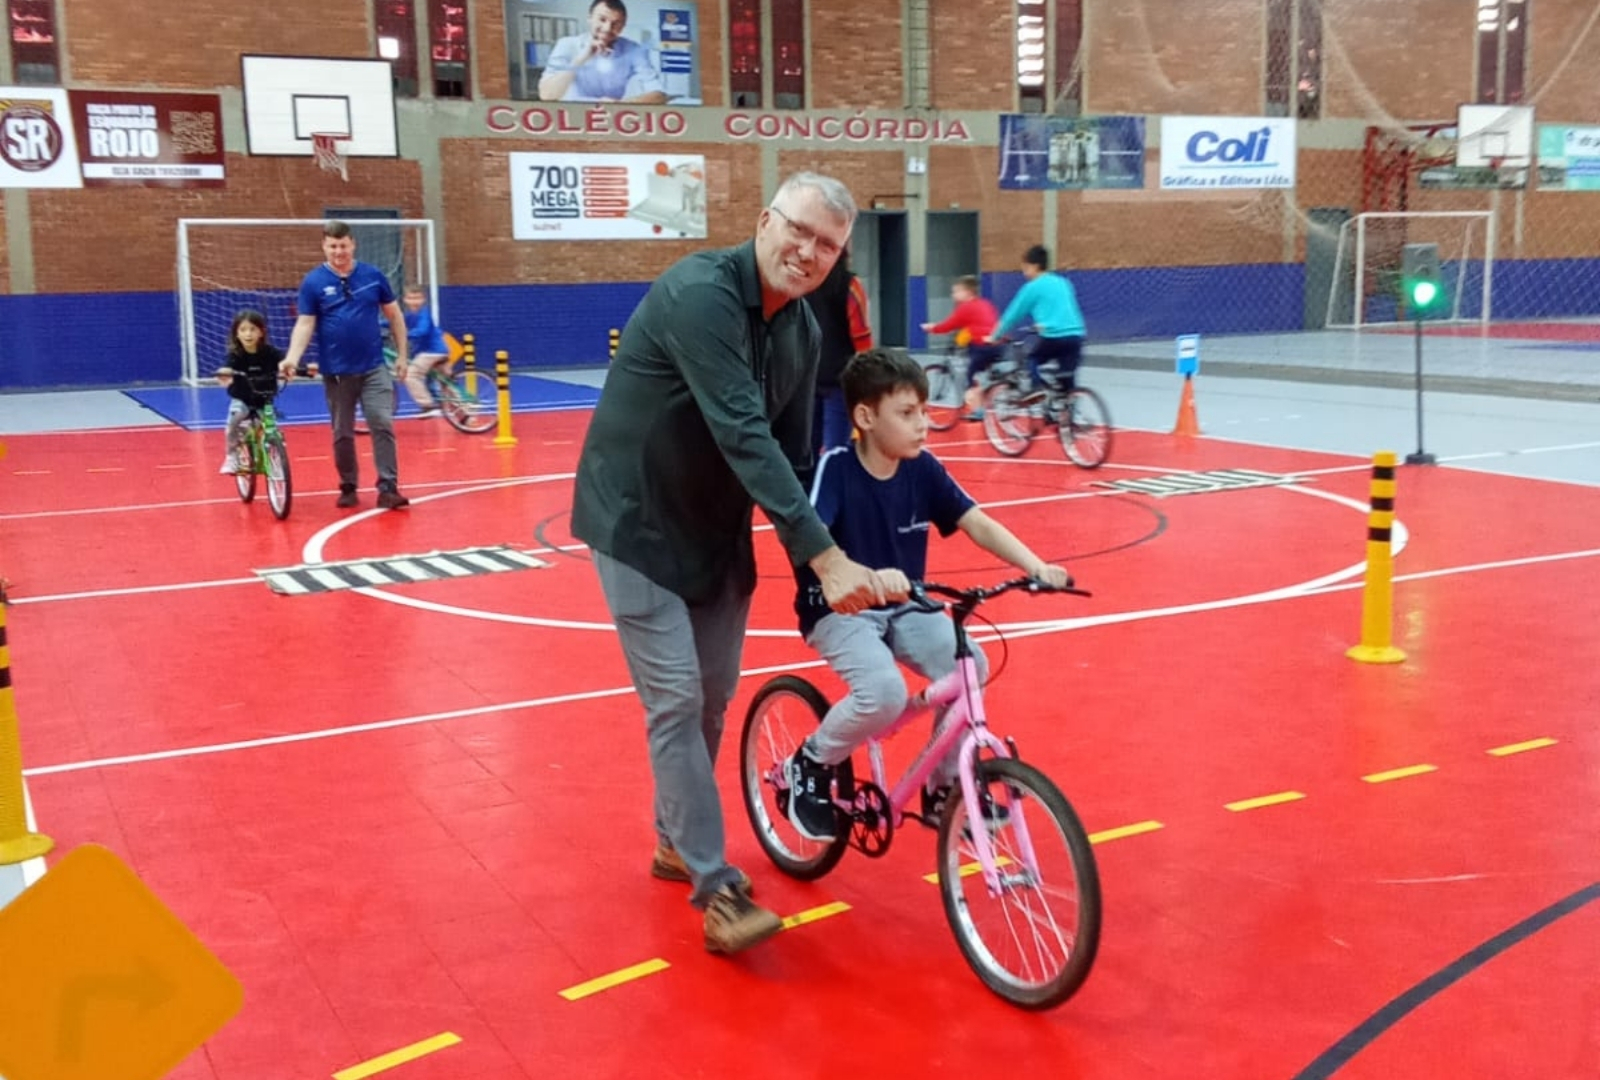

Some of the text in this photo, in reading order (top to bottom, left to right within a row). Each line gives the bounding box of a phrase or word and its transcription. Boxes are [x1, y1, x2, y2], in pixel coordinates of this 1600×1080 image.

[5, 117, 53, 161] SR
[486, 103, 972, 141] COLÉGIO CONCÓRDIA
[89, 127, 159, 158] ROJO
[1186, 126, 1272, 163] Coli
[529, 165, 578, 189] 700
[530, 190, 579, 207] MEGA
